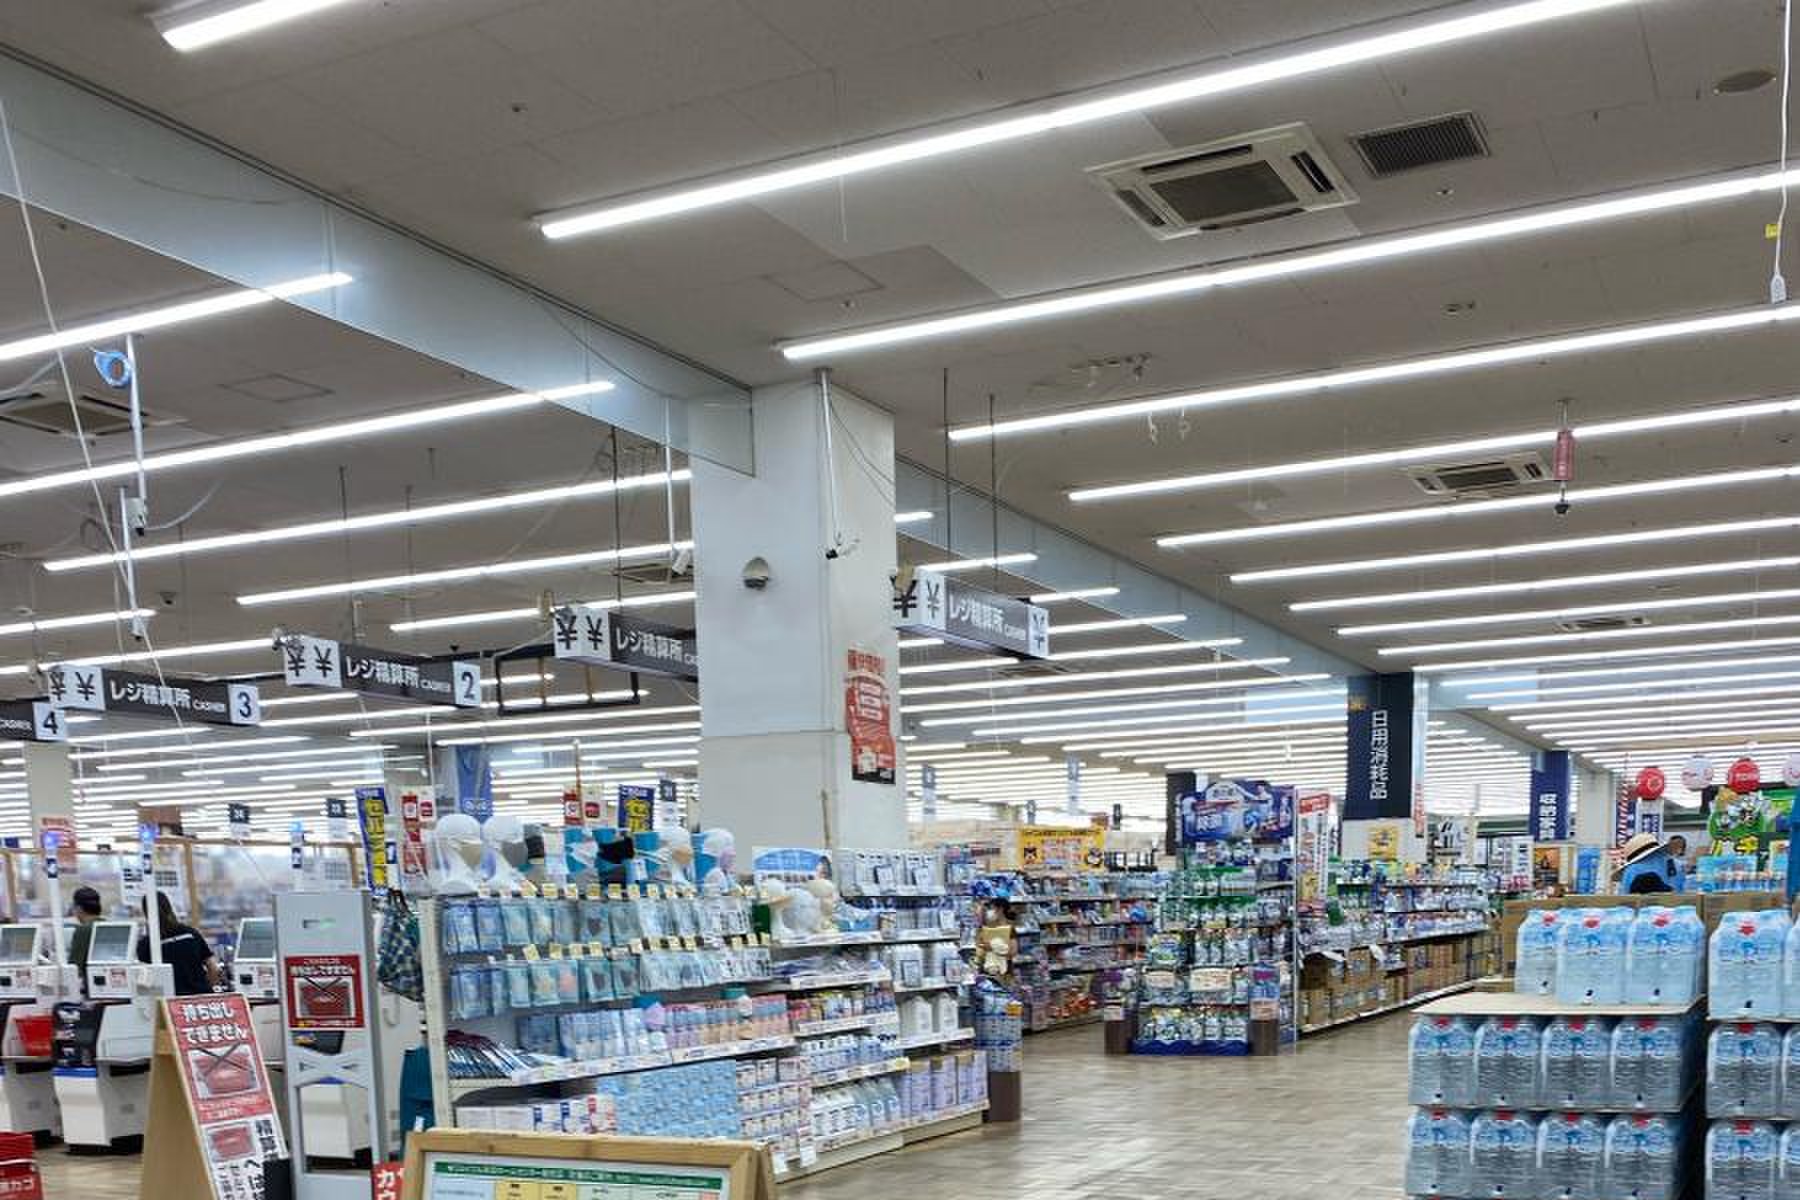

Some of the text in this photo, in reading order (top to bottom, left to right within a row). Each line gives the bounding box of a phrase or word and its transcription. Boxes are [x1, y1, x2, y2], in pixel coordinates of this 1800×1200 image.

[461, 671, 475, 699] 2
[237, 690, 252, 719] 3
[42, 711, 58, 734] 4
[182, 1001, 235, 1022] 持ち出し
[181, 1023, 248, 1044] できません
